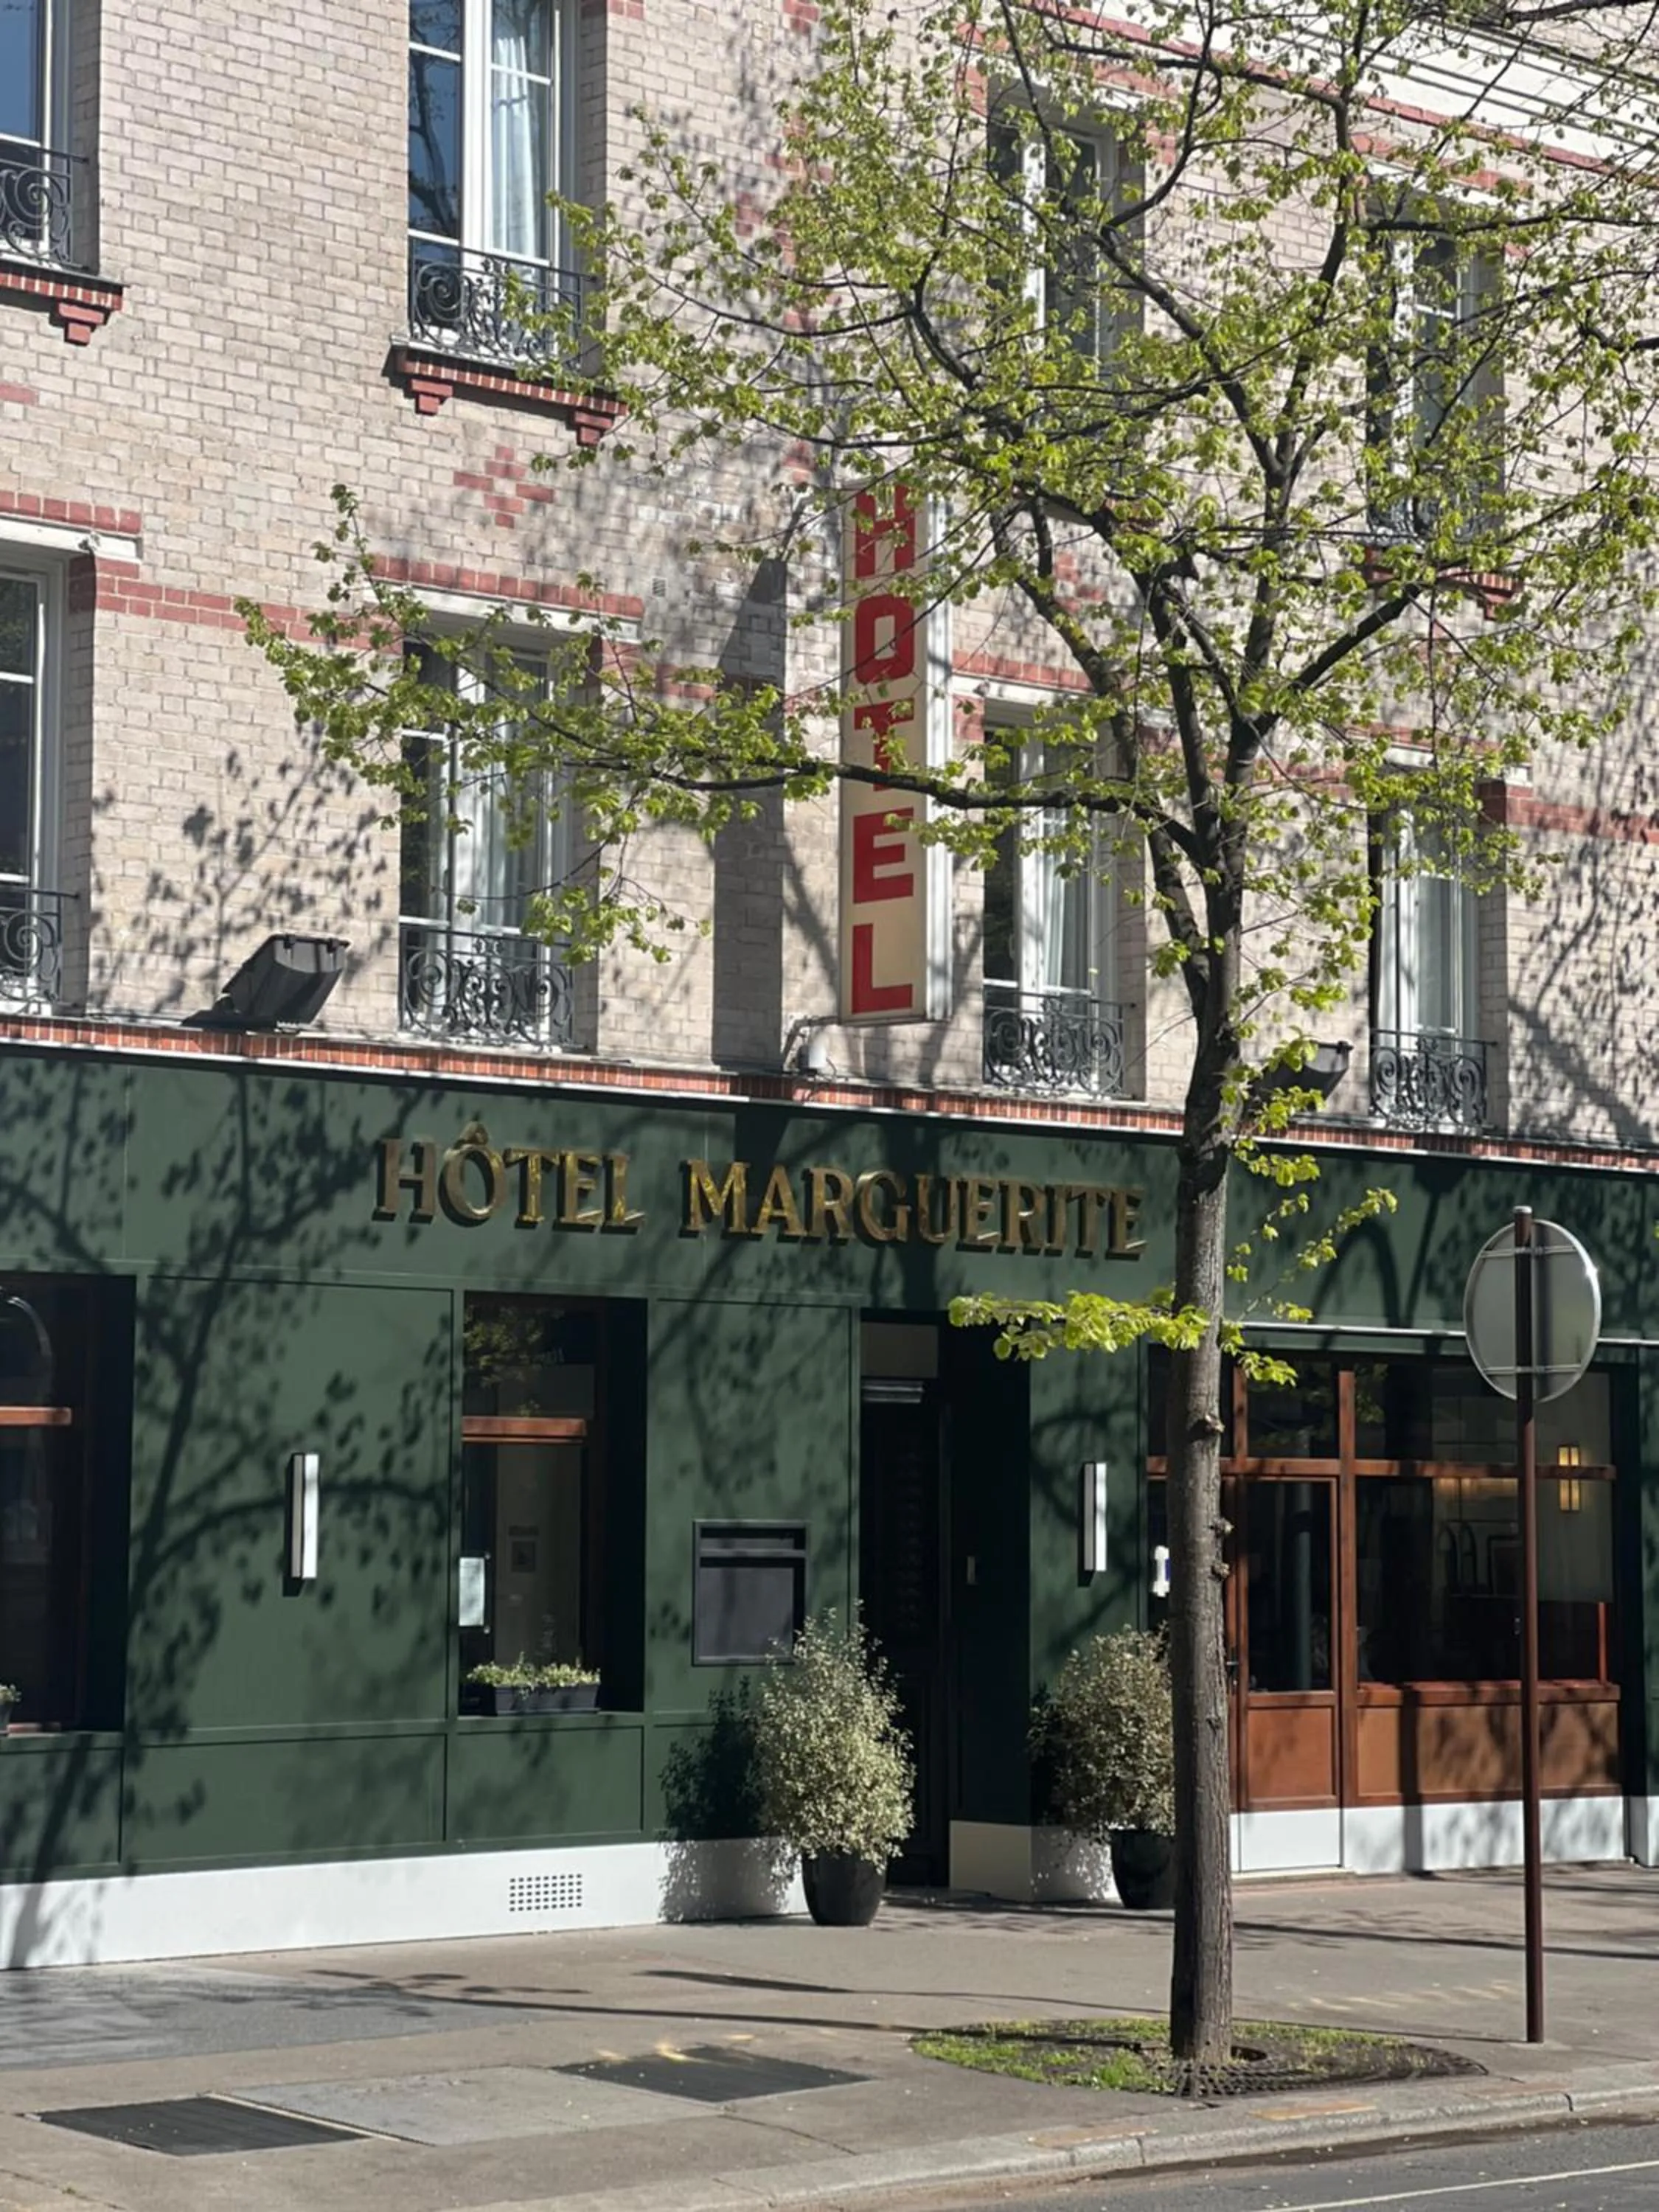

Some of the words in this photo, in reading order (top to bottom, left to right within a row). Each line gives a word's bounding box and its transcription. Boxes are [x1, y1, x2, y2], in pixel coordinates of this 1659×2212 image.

[852, 484, 915, 1014] HOTEL
[375, 1121, 645, 1232] HÔTEL
[681, 1159, 1147, 1258] MARGUERITE
